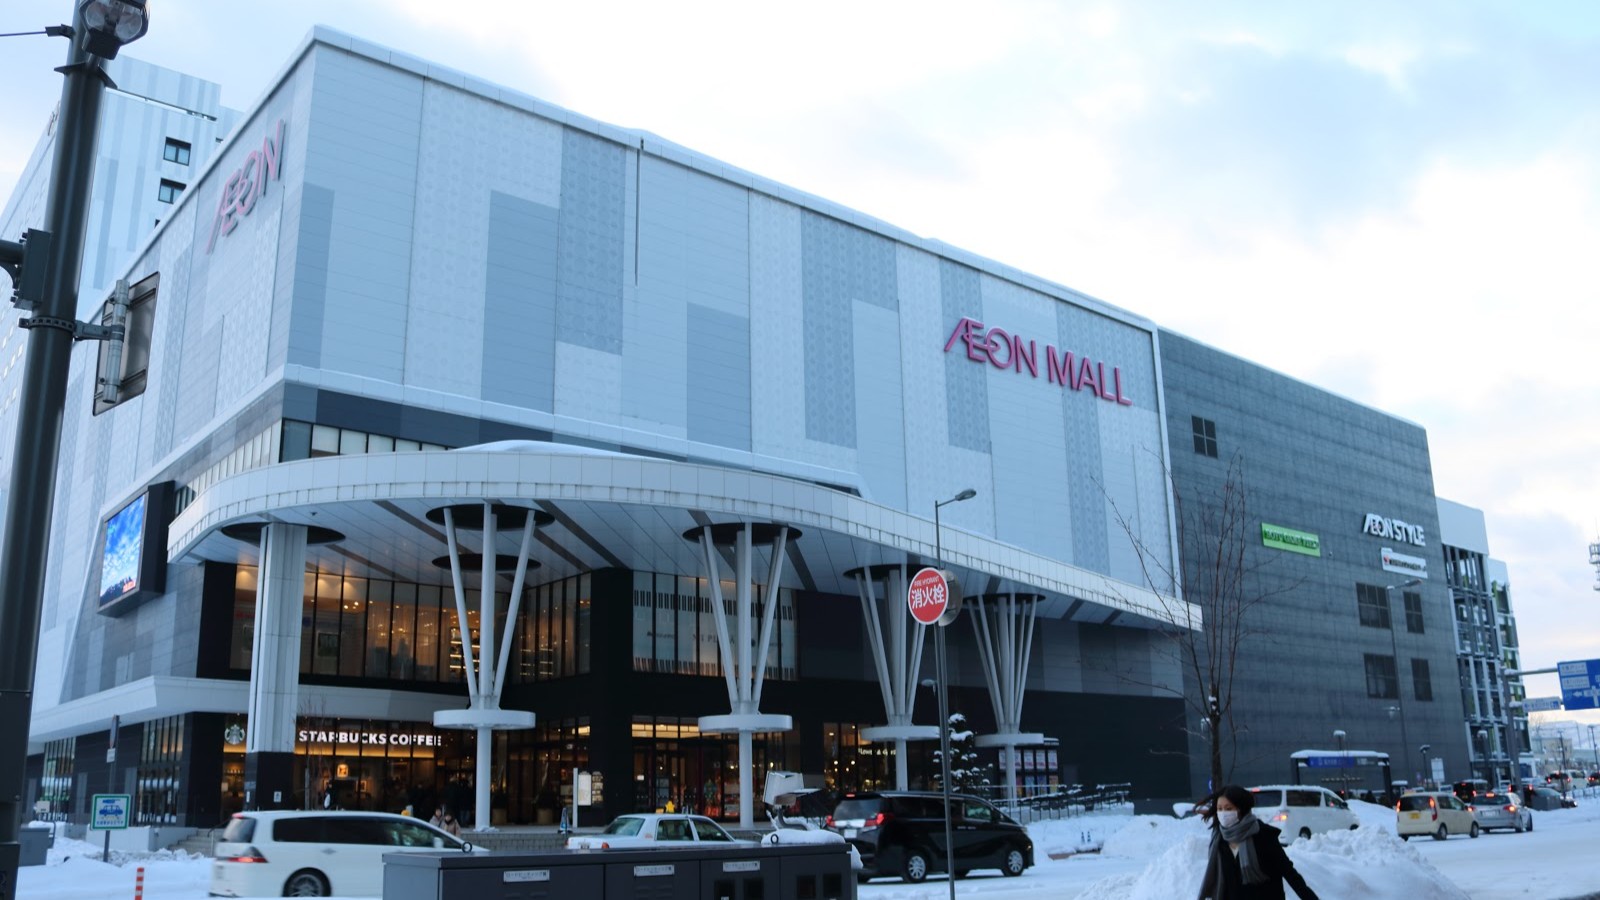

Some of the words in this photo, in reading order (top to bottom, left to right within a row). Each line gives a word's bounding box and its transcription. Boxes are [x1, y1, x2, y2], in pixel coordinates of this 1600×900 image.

[1046, 343, 1133, 406] MALL
[1392, 519, 1426, 546] STYLE
[911, 583, 945, 609] 消火栓
[299, 730, 387, 745] STARBUCKS
[389, 733, 442, 747] COFFEE
